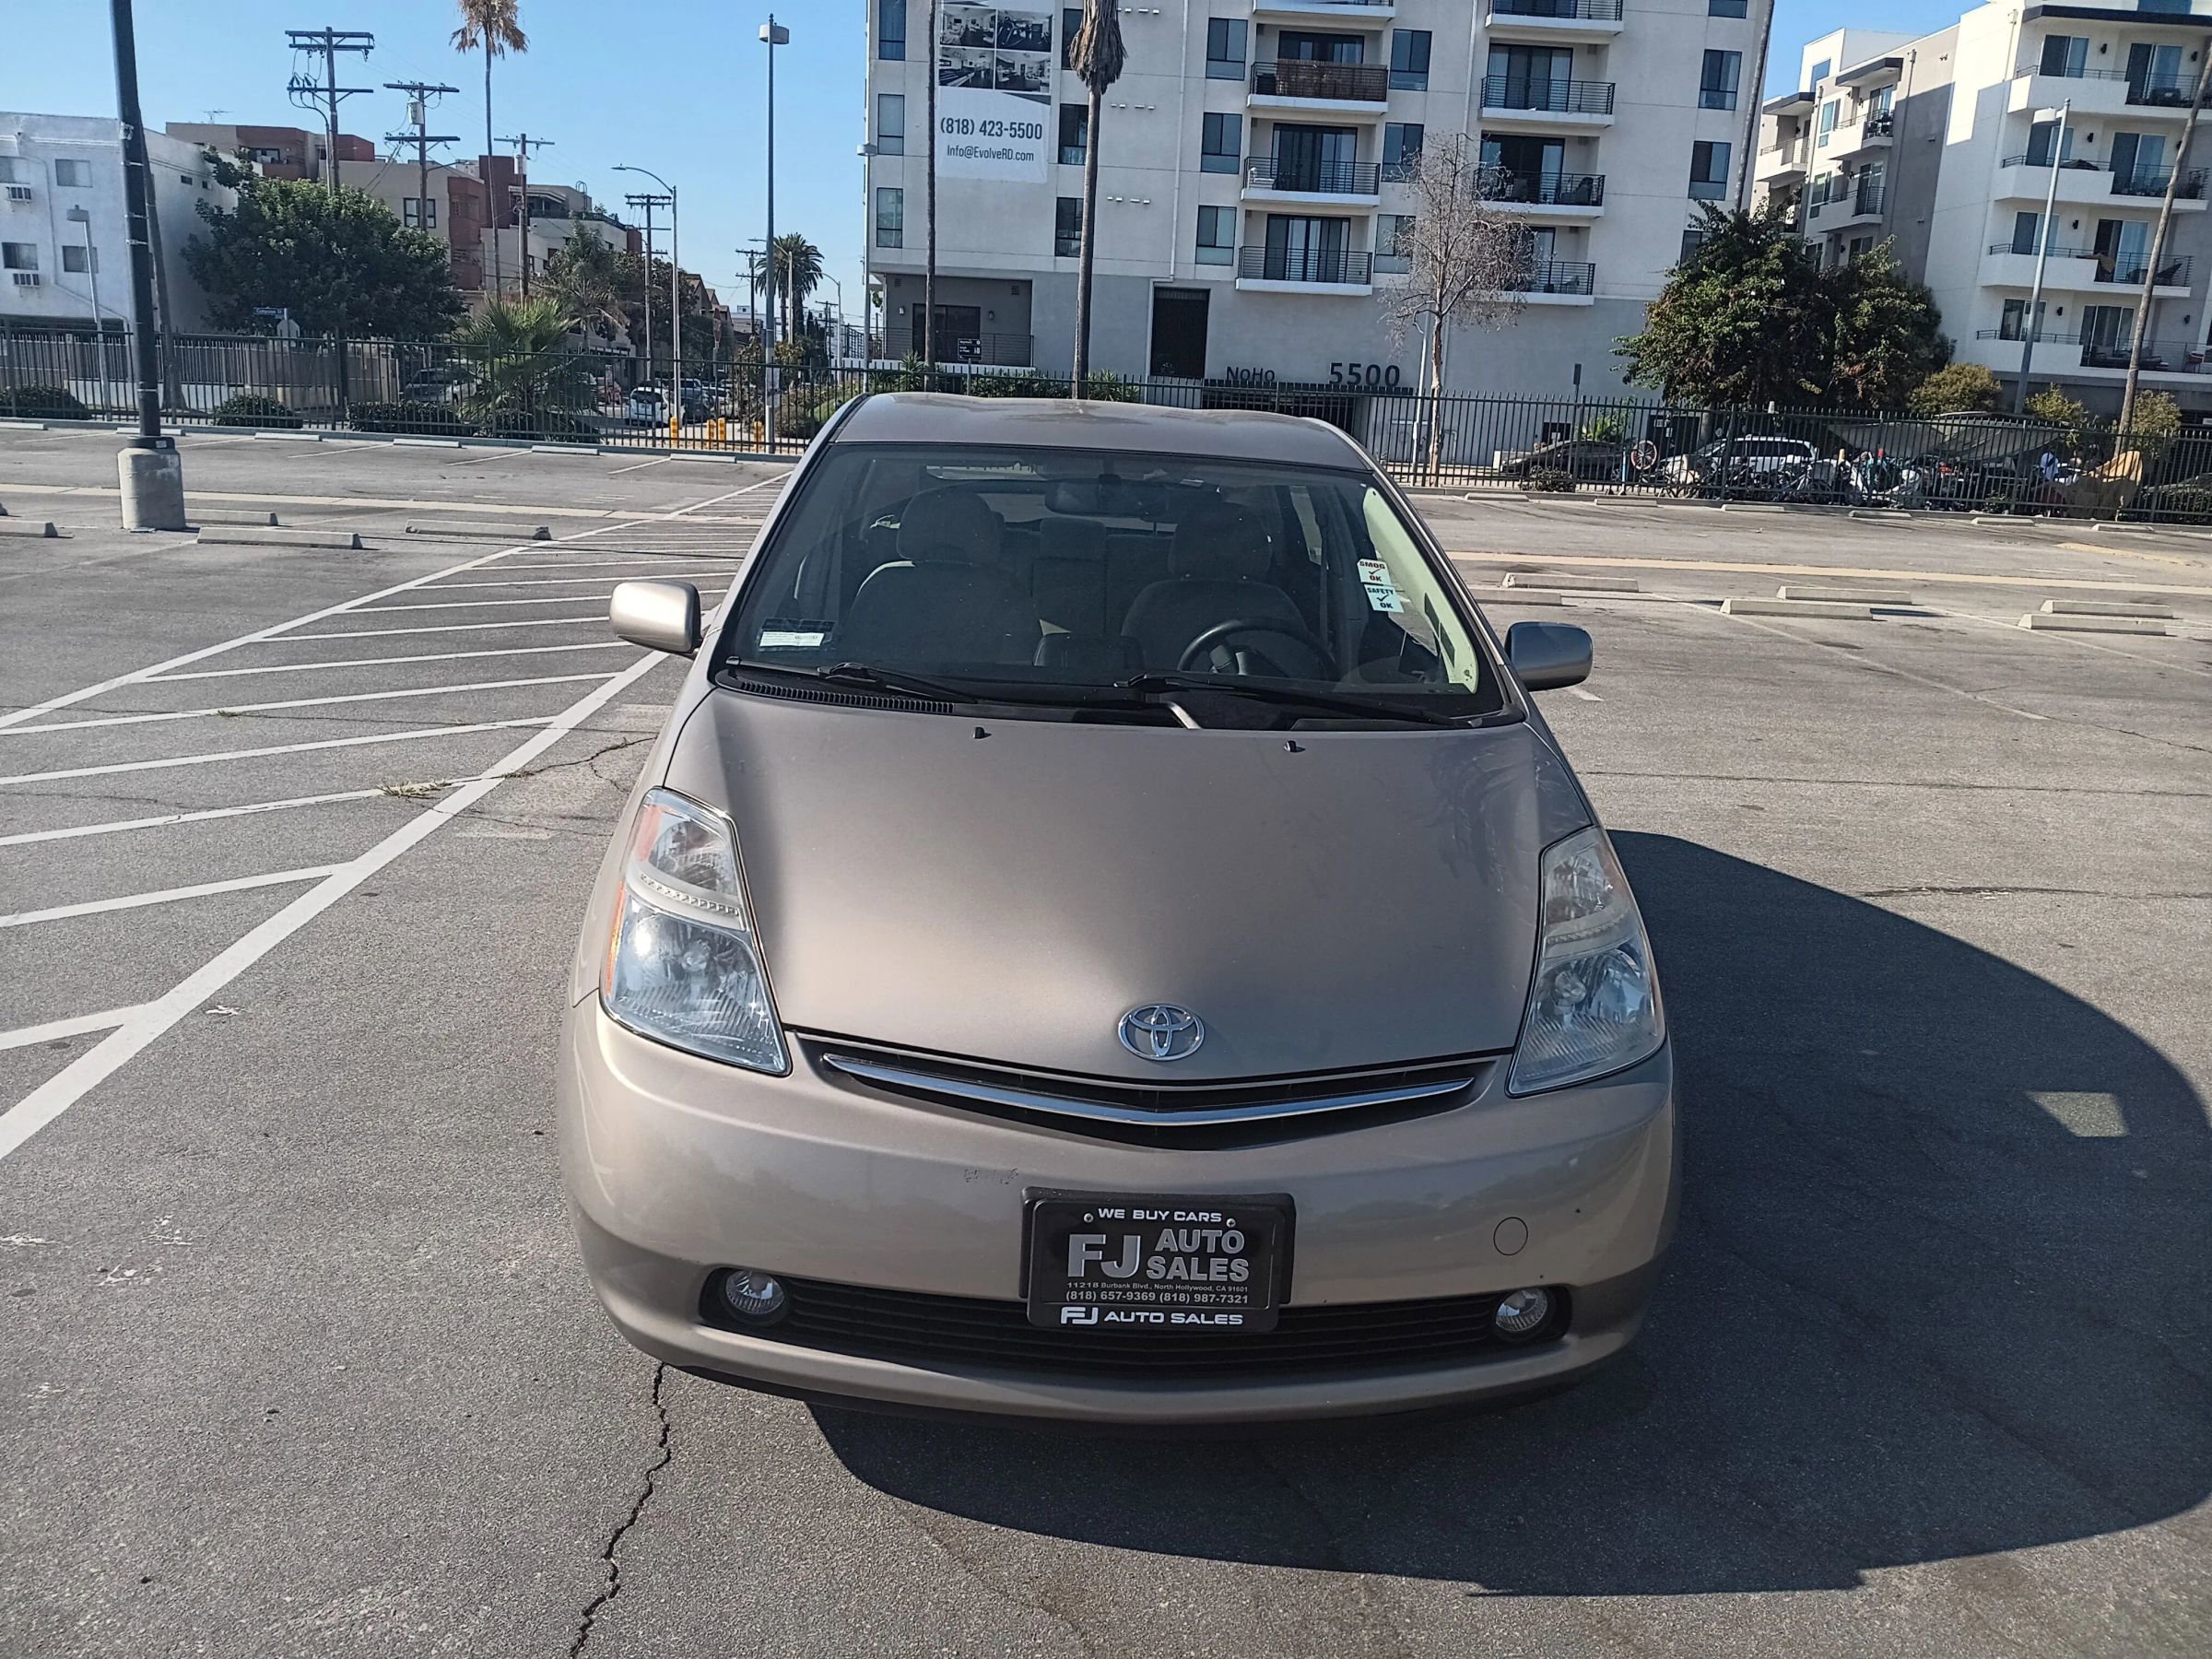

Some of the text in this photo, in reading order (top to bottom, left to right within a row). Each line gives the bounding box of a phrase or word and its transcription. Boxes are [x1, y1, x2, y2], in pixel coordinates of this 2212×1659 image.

[940, 117, 1042, 140] (818) 423-5500
[947, 145, 1034, 161] Info@EvolveRD.com
[1226, 362, 1400, 387] NoHo 5500
[1367, 587, 1394, 595] SAFETY
[1098, 1207, 1222, 1223] WE BUY CARS
[1155, 1229, 1245, 1254] AUTO
[1067, 1234, 1141, 1278] FJ
[1146, 1255, 1250, 1282] SALES
[1065, 1290, 1248, 1304] (818) 657-9369 (818) 987-7321
[1061, 1306, 1243, 1325] FJ AUTO SALES
